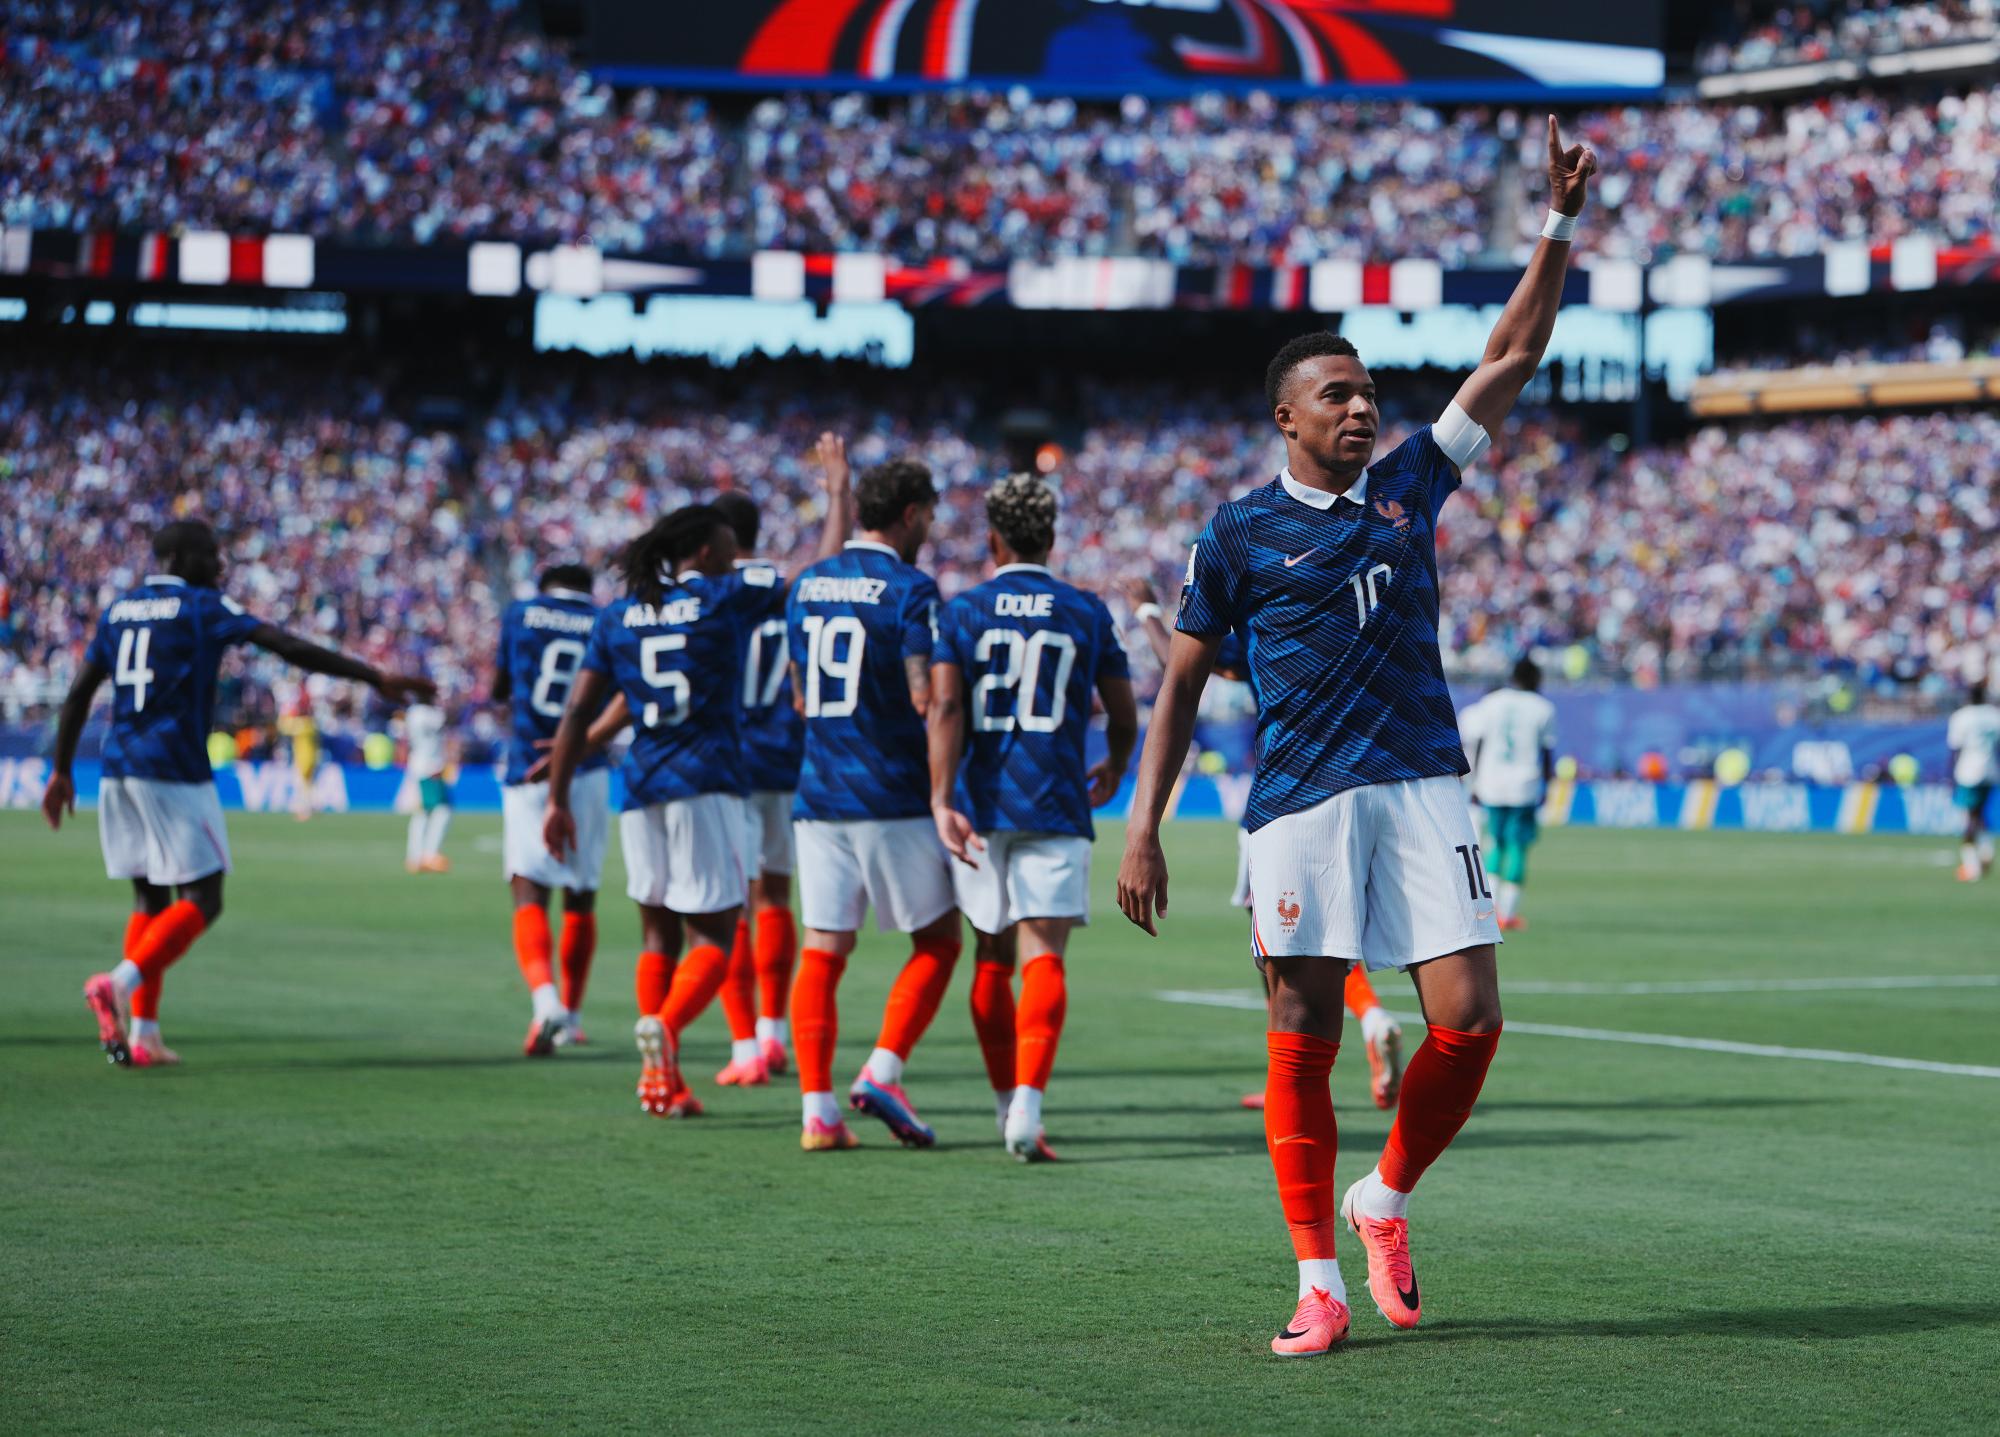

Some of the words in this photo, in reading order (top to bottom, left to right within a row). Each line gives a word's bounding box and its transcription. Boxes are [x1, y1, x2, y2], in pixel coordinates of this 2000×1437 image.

[994, 592, 1055, 617] DOUE
[115, 627, 154, 713] 4
[531, 637, 586, 718] 8
[640, 633, 690, 728] 5
[743, 619, 789, 708] 17
[802, 615, 866, 718] 19
[972, 628, 1076, 733] 20
